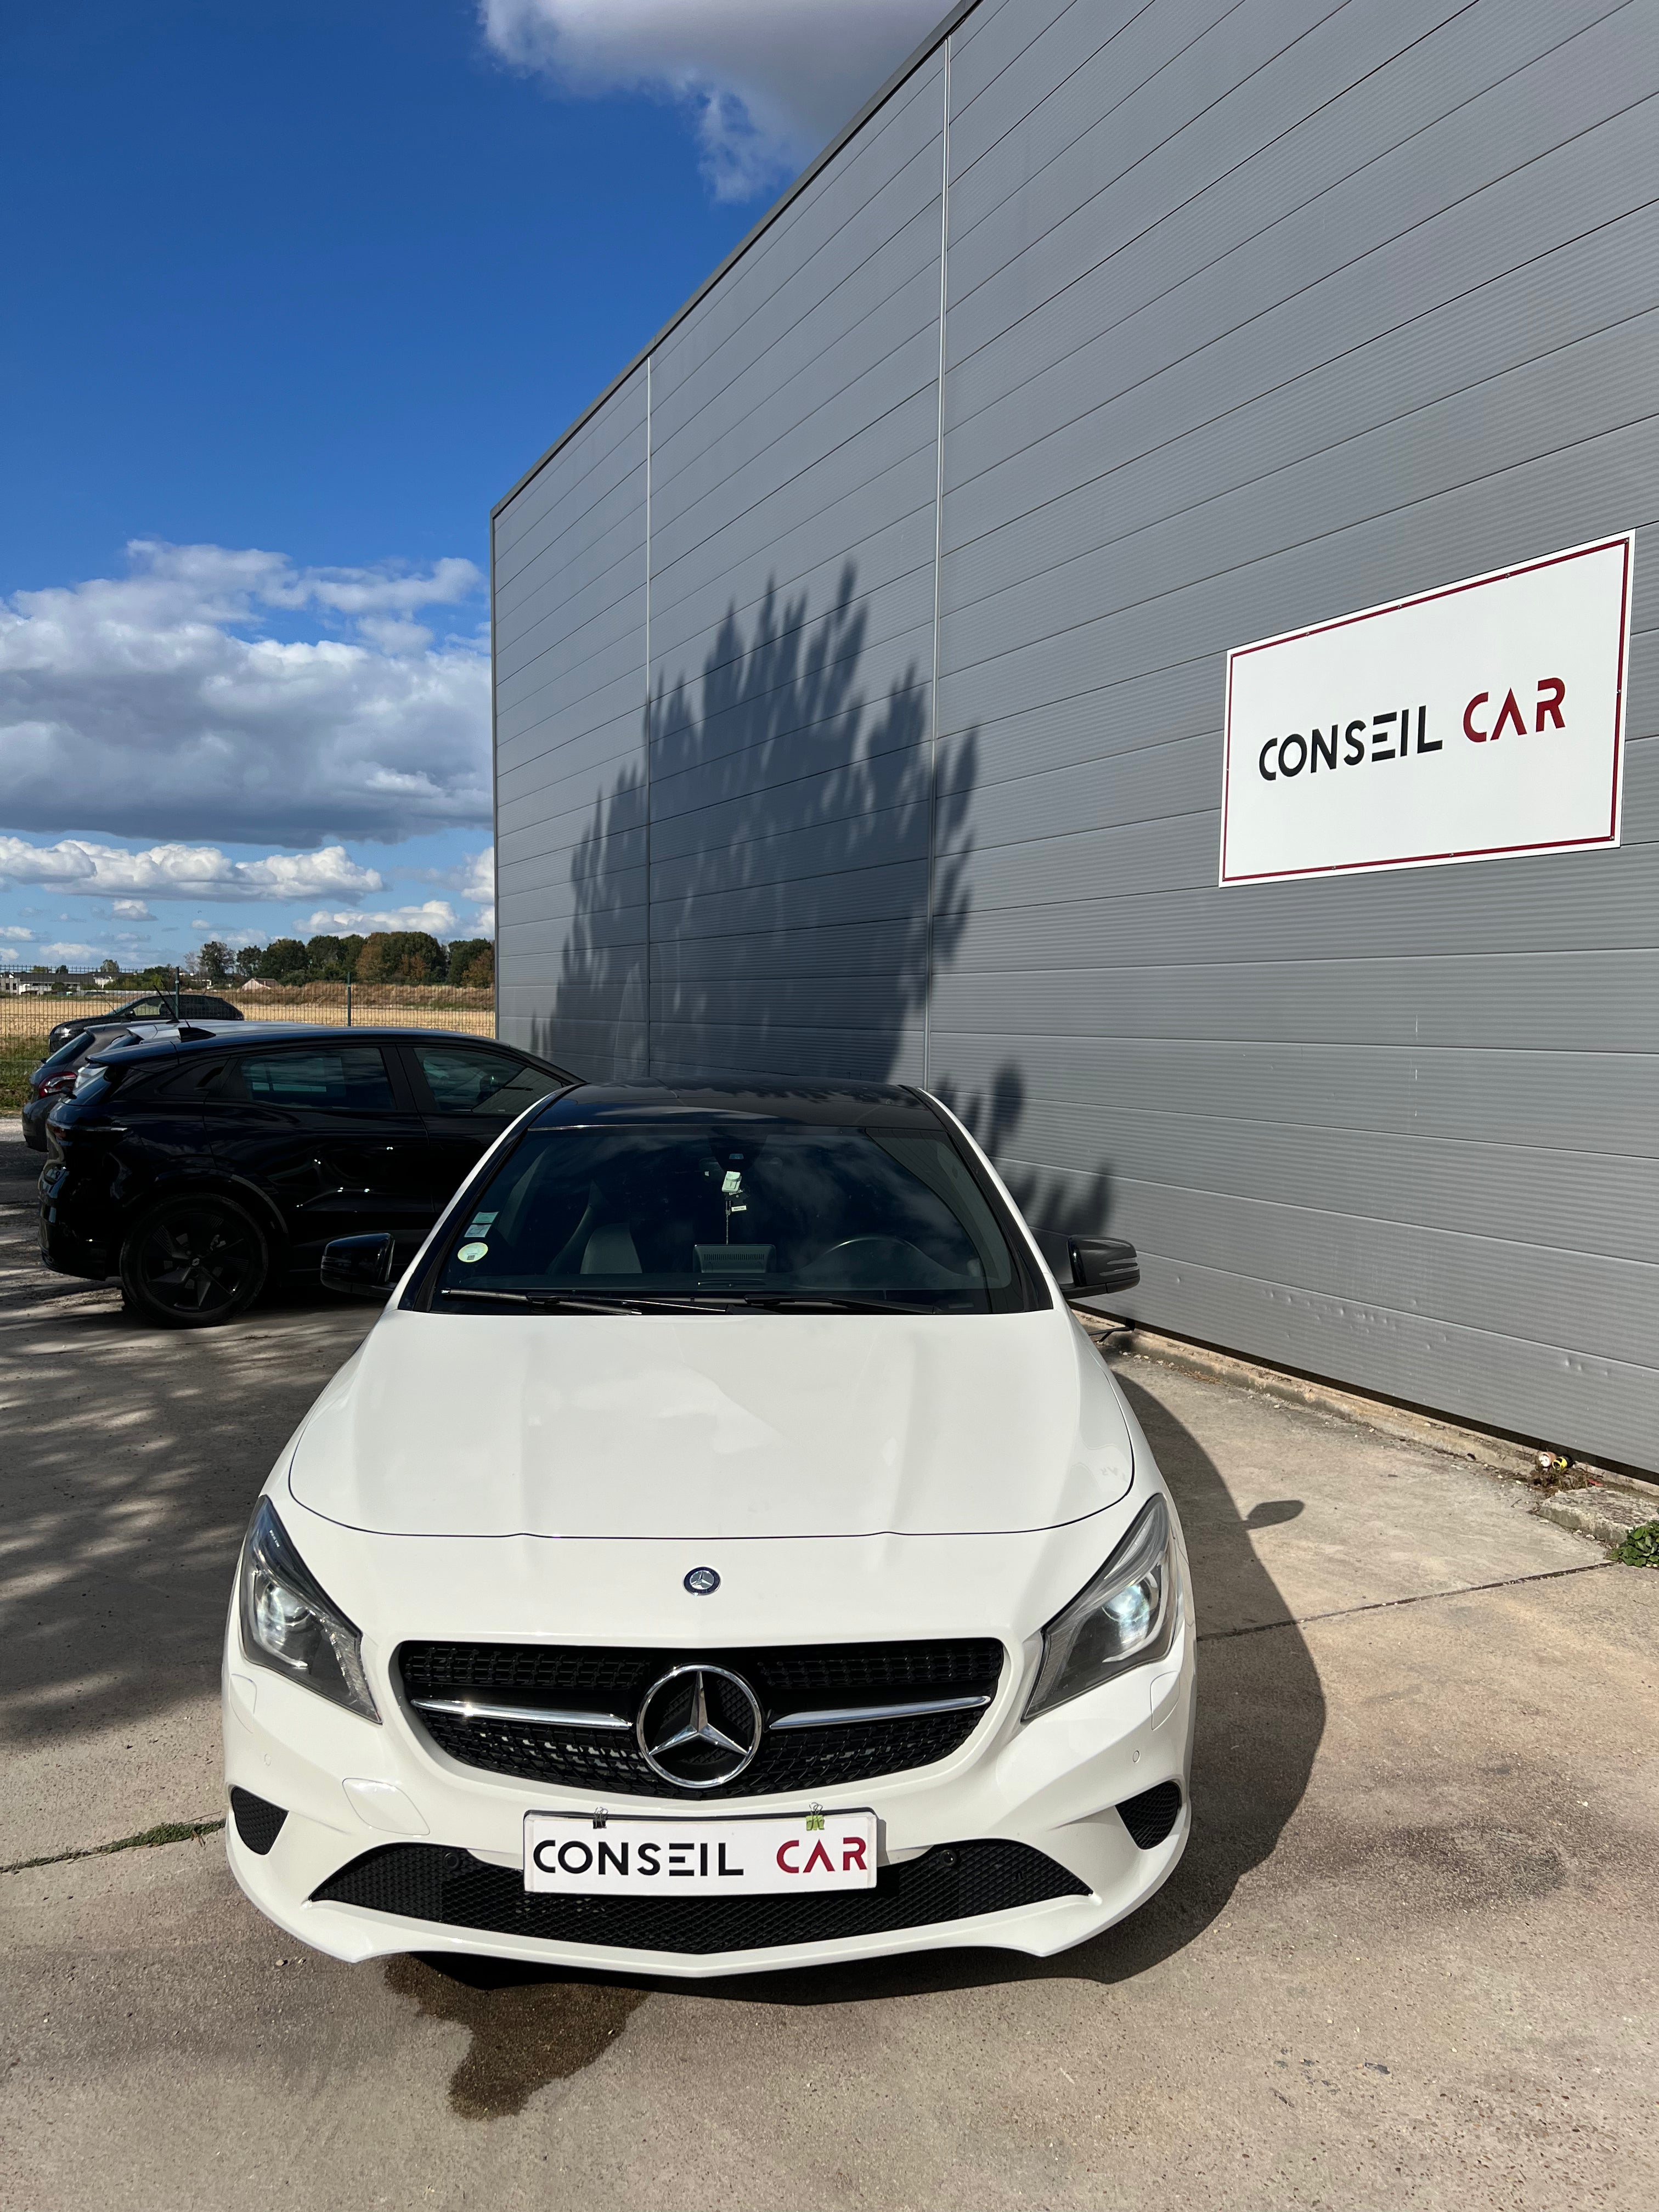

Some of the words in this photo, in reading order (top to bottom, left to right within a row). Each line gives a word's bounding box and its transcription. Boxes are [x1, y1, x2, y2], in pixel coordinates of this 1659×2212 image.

[1259, 705, 1443, 781] CONSEIL
[1463, 677, 1566, 743] CAR
[533, 1839, 744, 1876] CONSEIL
[776, 1837, 867, 1873] CAR
